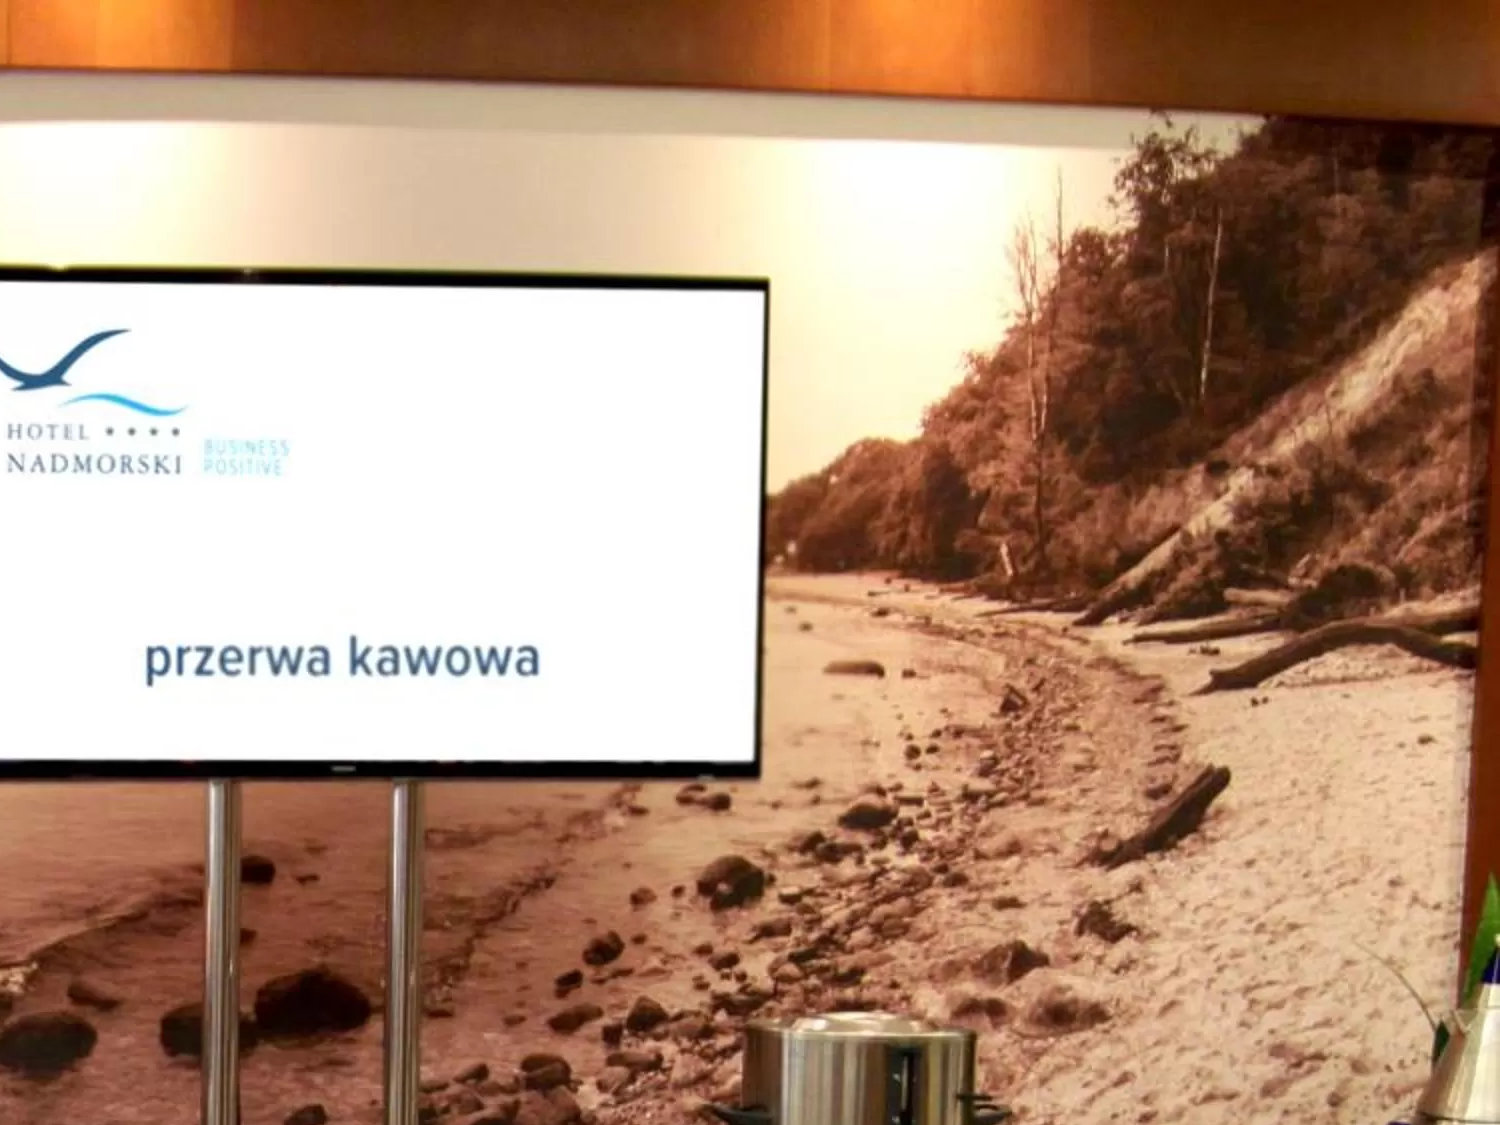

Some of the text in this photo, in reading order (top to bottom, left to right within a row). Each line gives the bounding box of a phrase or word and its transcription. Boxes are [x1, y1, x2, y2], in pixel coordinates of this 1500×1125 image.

[6, 423, 90, 441] HOTEL
[203, 439, 291, 457] BUSINESS
[6, 452, 183, 475] NADMORSKI
[203, 458, 282, 476] POSITIVE
[146, 634, 541, 687] przerwa kawowa
